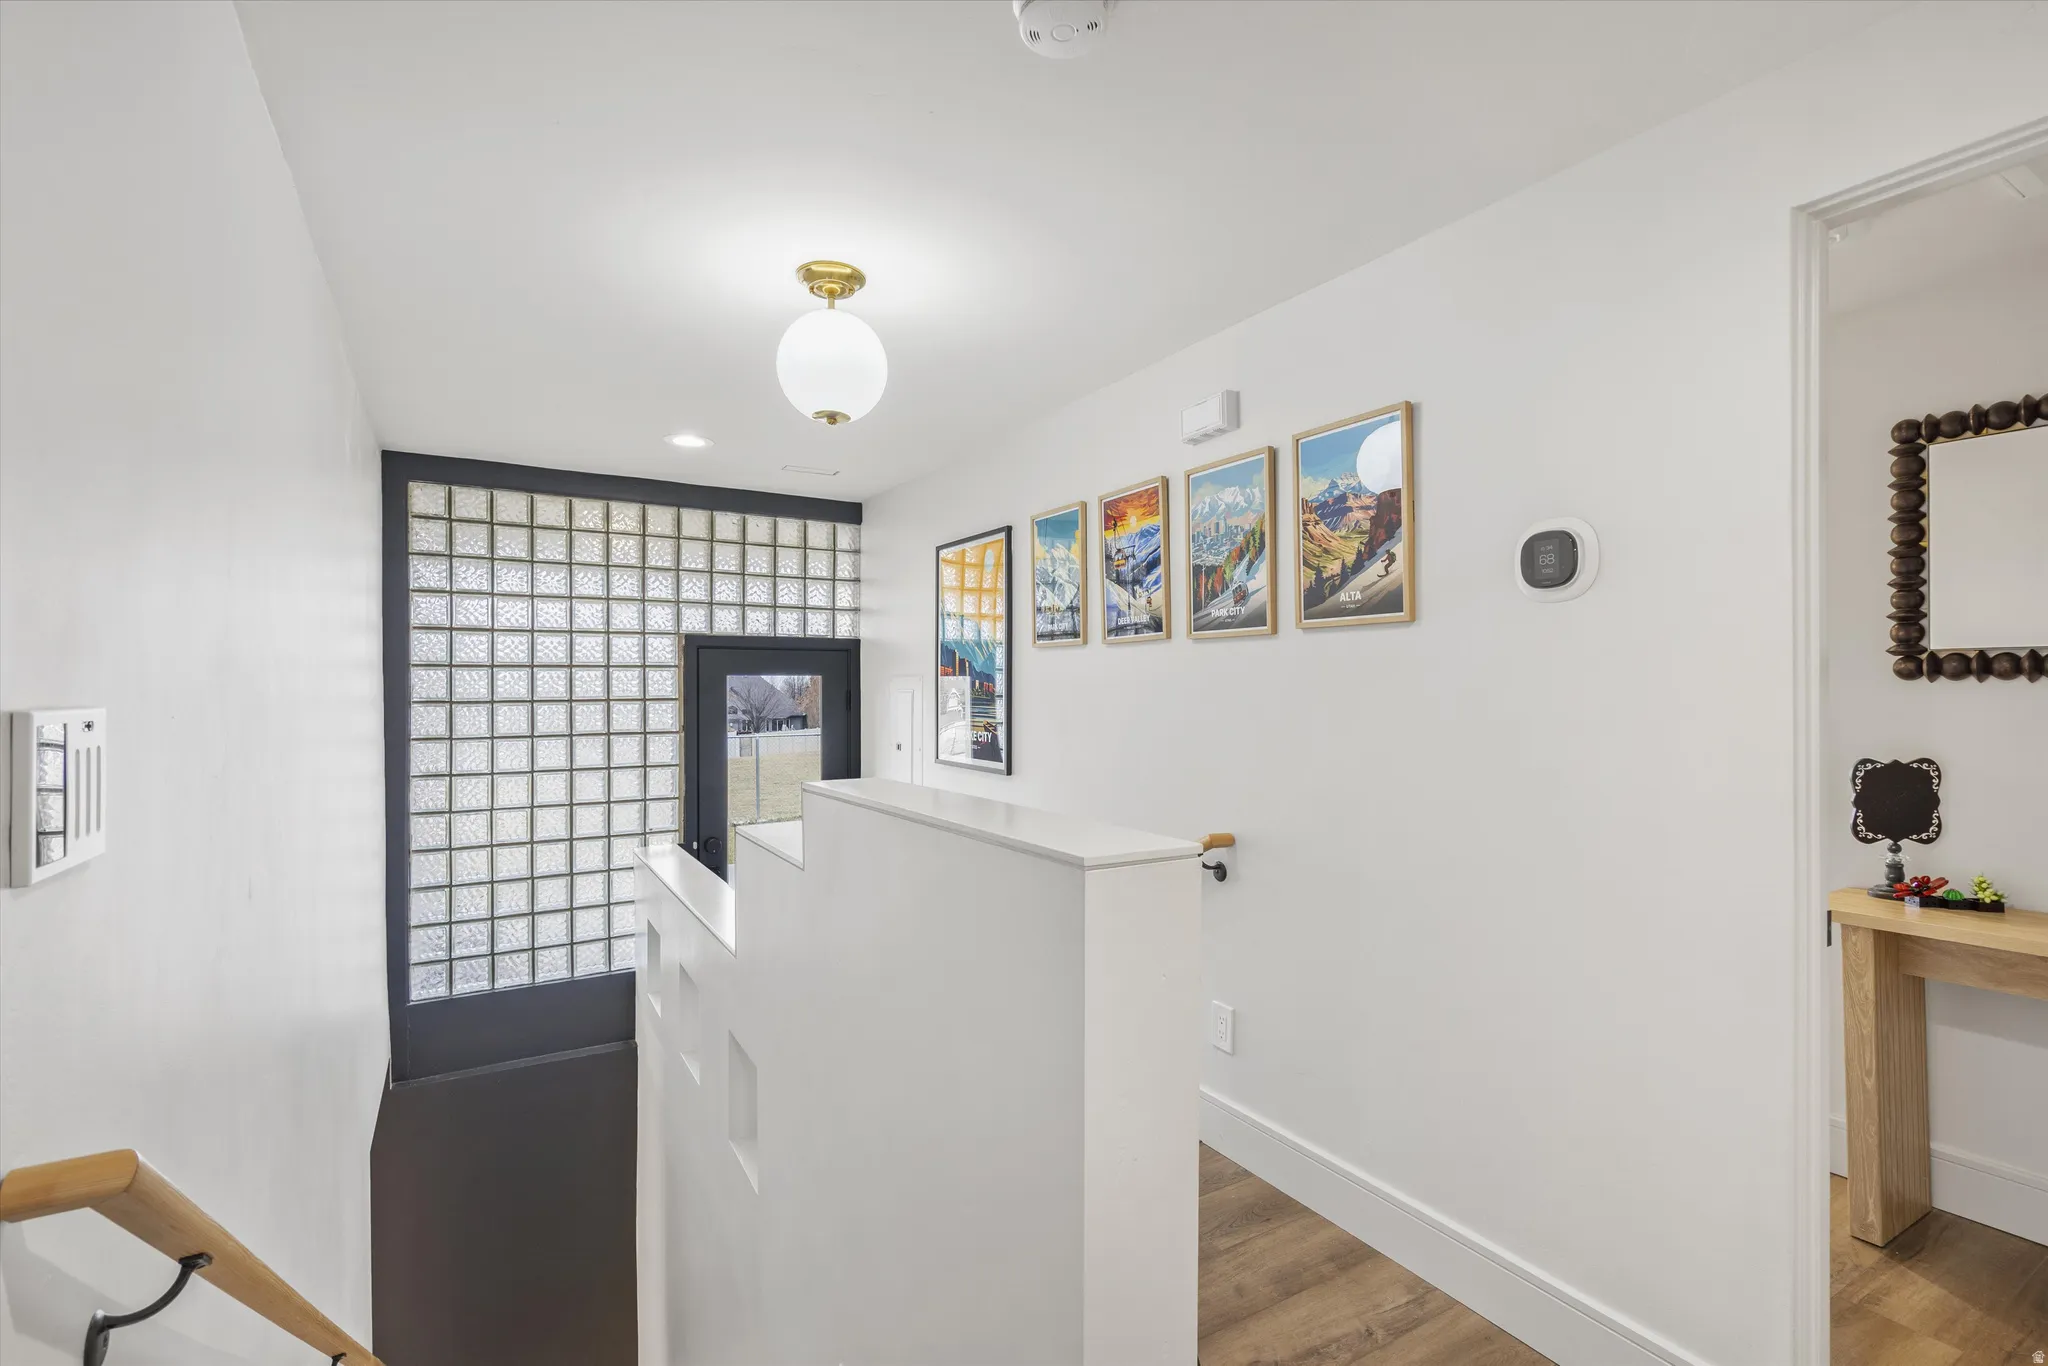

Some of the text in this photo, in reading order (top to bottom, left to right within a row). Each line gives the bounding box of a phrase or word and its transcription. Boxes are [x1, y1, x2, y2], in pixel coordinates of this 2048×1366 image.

[1539, 553, 1555, 566] 68
[1339, 590, 1362, 602] ALTA
[1211, 606, 1246, 618] PARK CITY
[1117, 613, 1151, 625] DEER VALLEY
[977, 730, 992, 743] CITY
